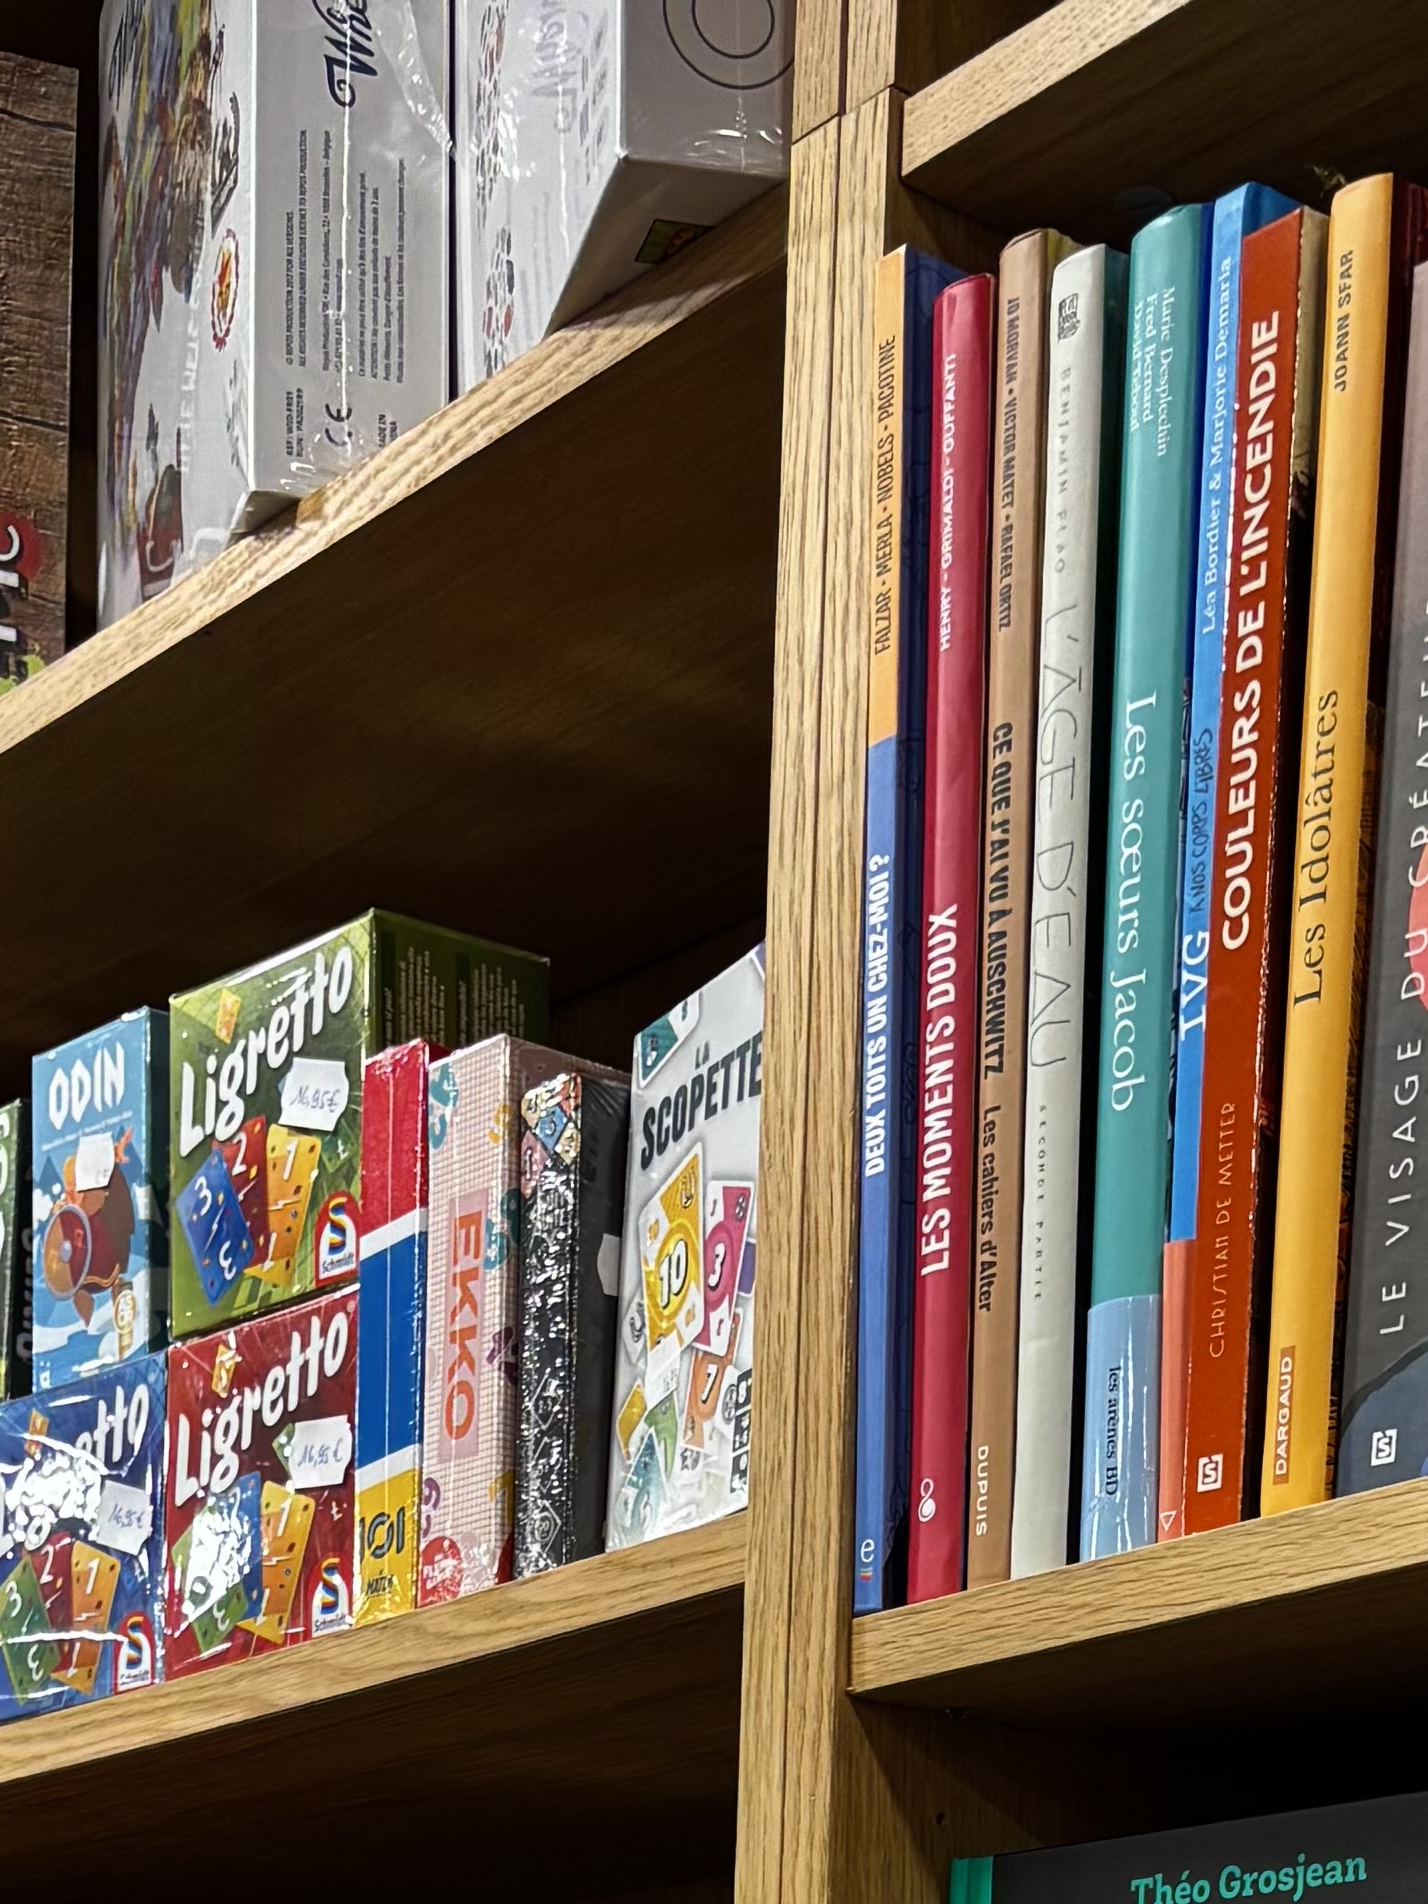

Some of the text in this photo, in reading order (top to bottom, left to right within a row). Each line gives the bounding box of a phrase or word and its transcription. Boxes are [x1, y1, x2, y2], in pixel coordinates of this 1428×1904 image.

[1333, 249, 1354, 392] JOANN SFAR
[1221, 311, 1281, 951] COULEURS DE L'INCENDIE
[984, 722, 1013, 1080] CE QUE J'AI VU À AUSCHWITZ
[1111, 690, 1156, 1111] Les sœurs Jacob
[1294, 689, 1340, 1008] Les Idolâtres
[177, 945, 354, 1163] Ligretto
[1179, 929, 1210, 1042] IVG
[1400, 927, 1428, 1002] DU
[48, 1040, 125, 1132] ODIN
[920, 904, 959, 1277] LES MOMENTS DOUX
[1382, 1037, 1423, 1248] VISAGE
[173, 1310, 349, 1507] Ligretto
[442, 1209, 484, 1443] EKKO
[1380, 1280, 1406, 1336] LE
[975, 1445, 990, 1537] DUPUIS
[1275, 1356, 1293, 1476] DARGAUD
